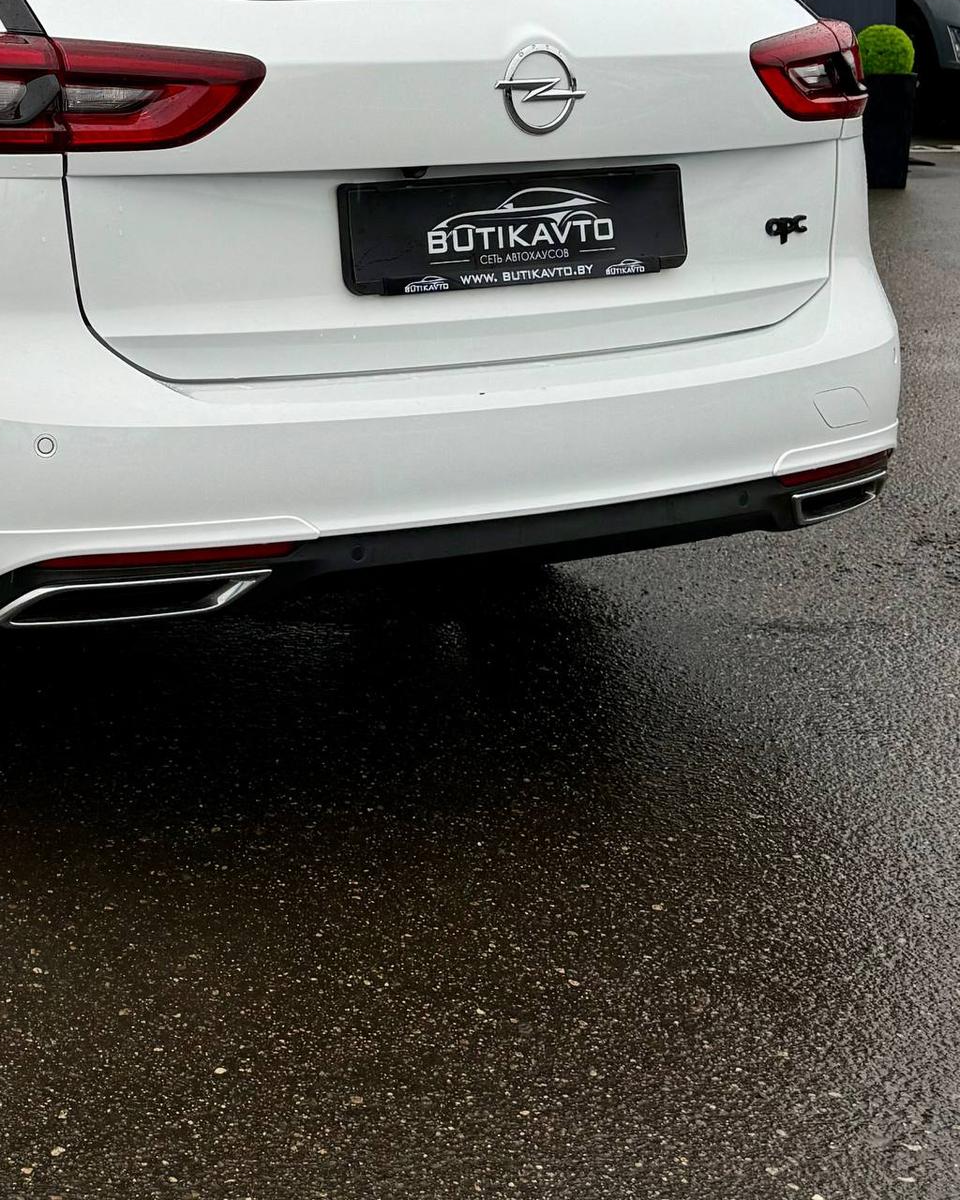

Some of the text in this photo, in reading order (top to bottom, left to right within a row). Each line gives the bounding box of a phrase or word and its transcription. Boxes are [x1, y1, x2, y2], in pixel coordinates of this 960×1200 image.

[427, 218, 614, 254] BUTIKAVTO
[480, 249, 570, 265] СЕТЬ АВТОХАУСОВ
[460, 265, 594, 285] WWW. BUTIKAVTO.BY
